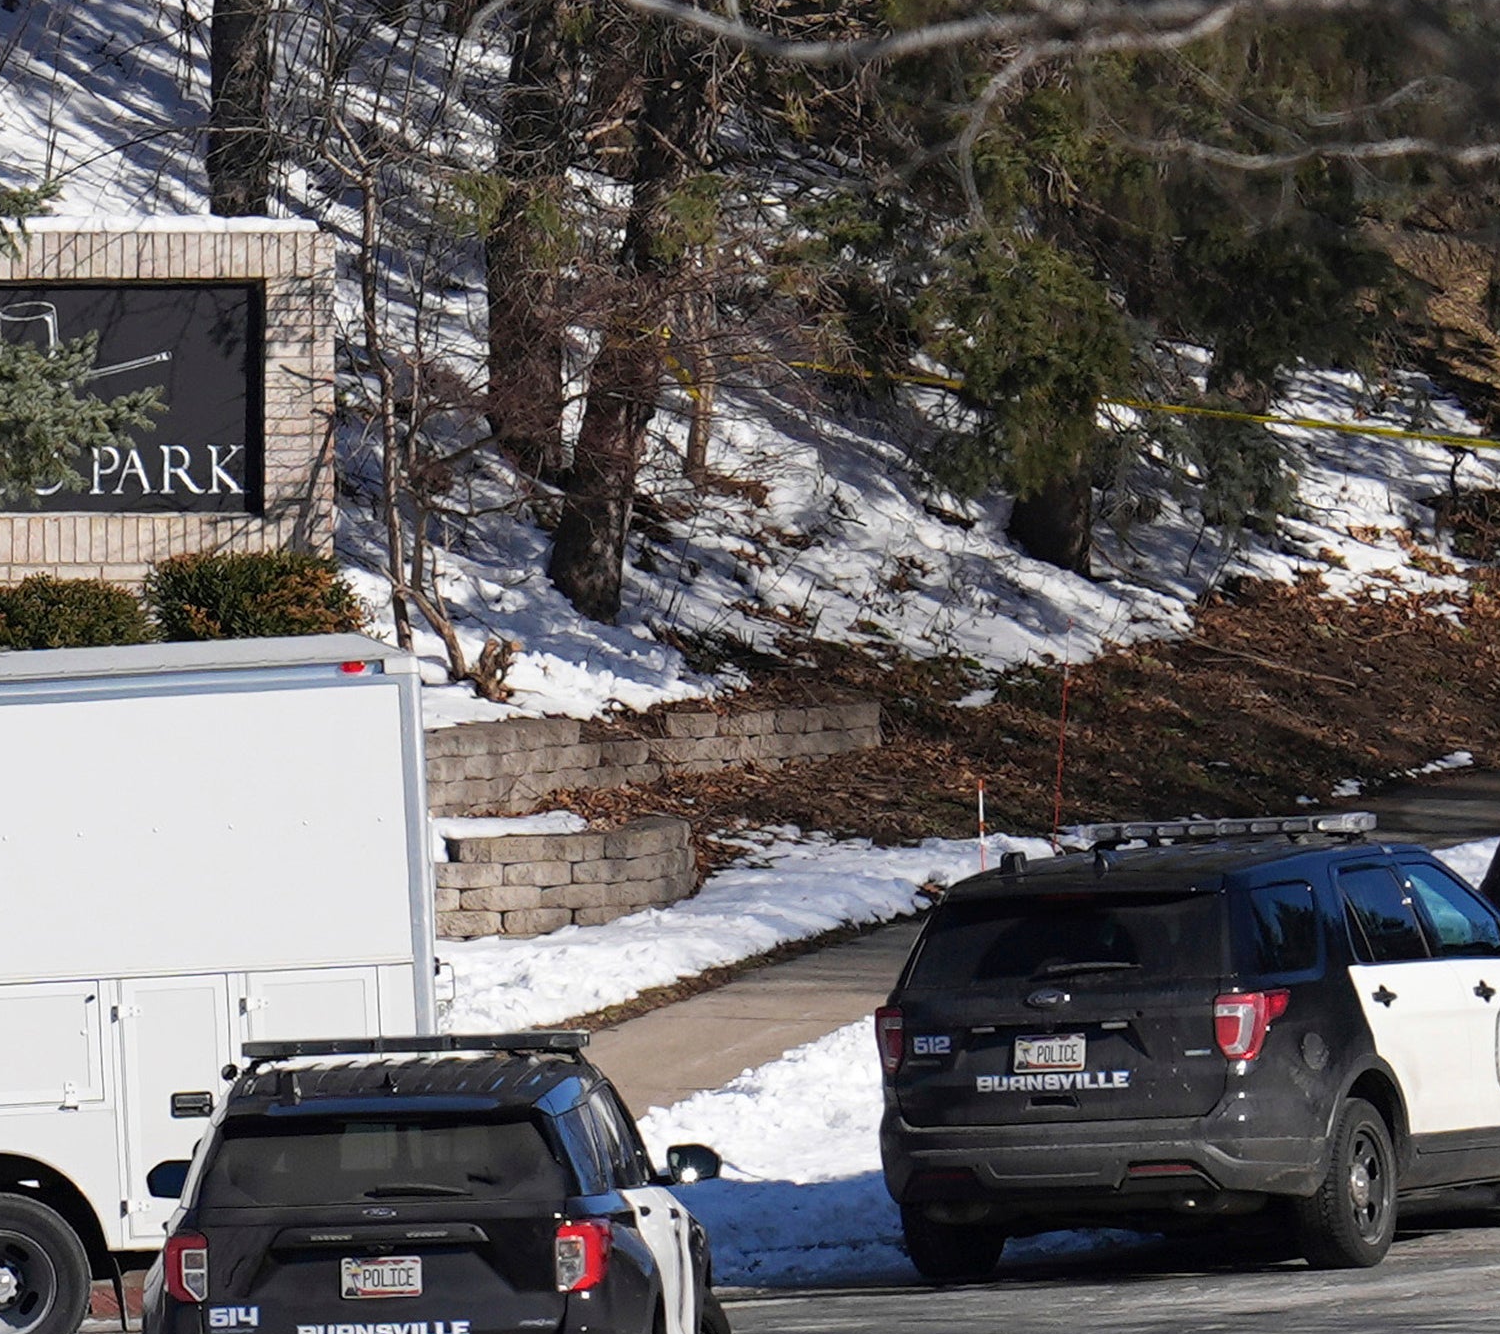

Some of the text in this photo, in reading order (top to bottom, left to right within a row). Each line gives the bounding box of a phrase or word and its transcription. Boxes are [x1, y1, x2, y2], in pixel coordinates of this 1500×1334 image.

[88, 443, 246, 495] PARK
[914, 1036, 951, 1055] 512
[1036, 1043, 1078, 1064] POLICE
[976, 1070, 1130, 1093] BURNSVILLE
[363, 1267, 415, 1287] POLICE
[209, 1306, 259, 1327] 514
